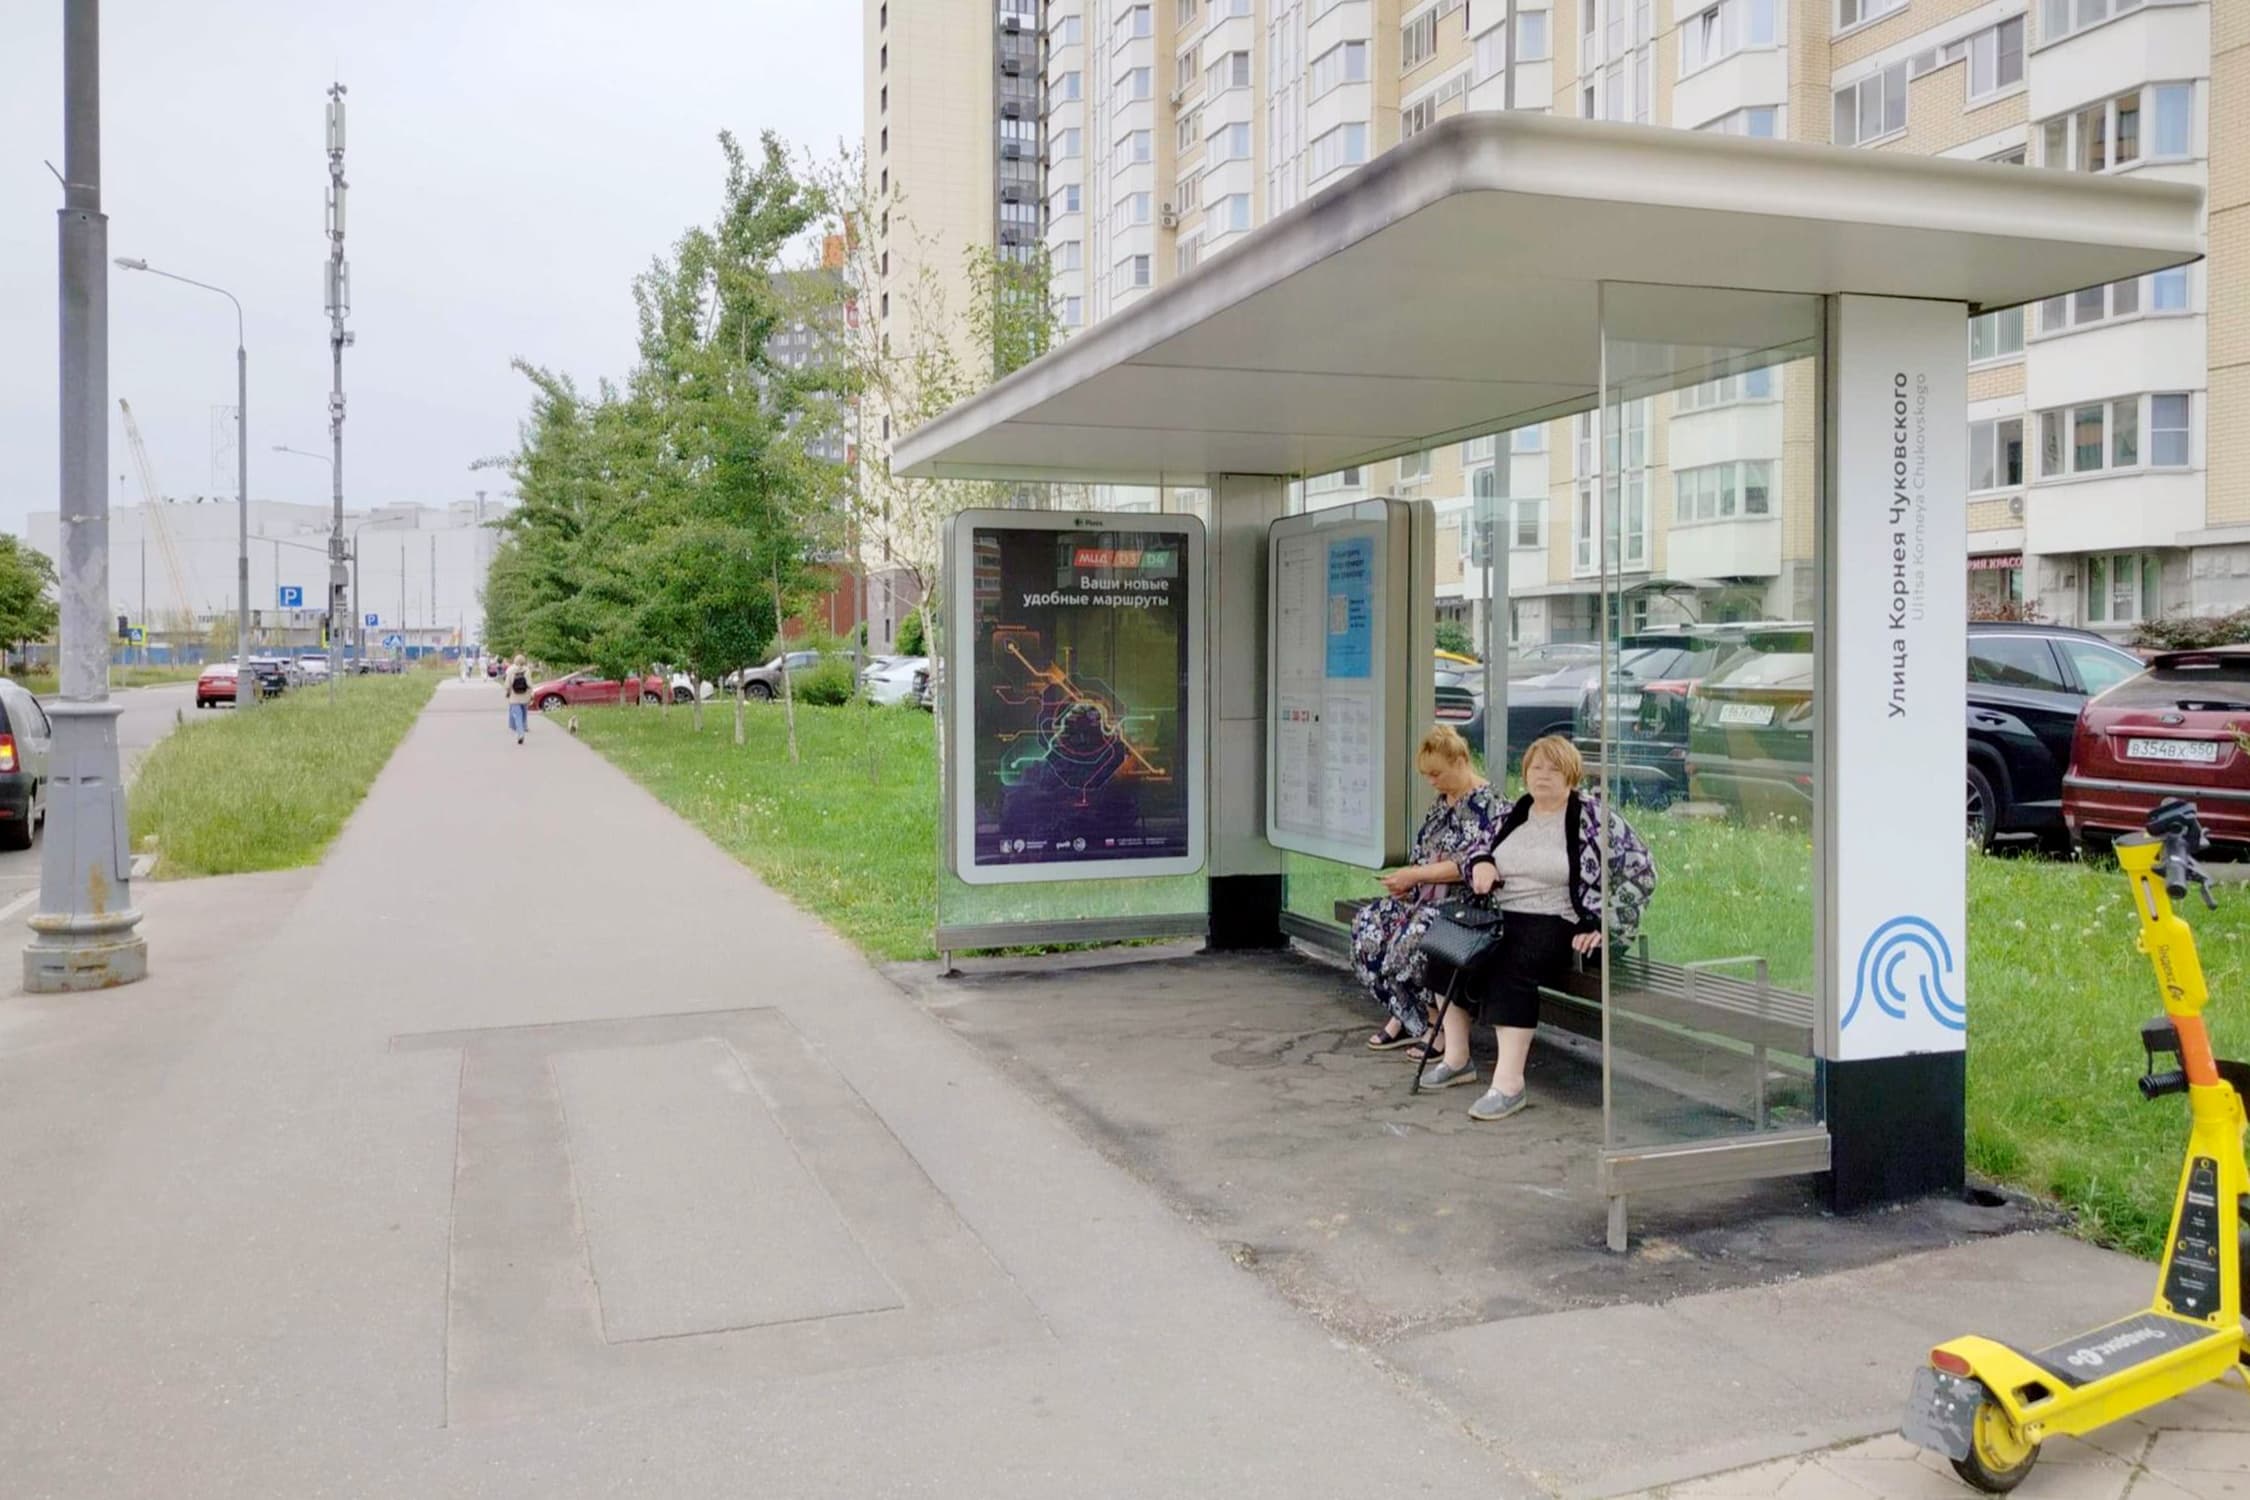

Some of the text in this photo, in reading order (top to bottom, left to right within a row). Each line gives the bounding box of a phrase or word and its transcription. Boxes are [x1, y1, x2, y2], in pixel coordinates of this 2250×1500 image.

[1911, 372, 1928, 621] Ulitsa Korneya Chukovskogo
[1888, 372, 1911, 719] Улица Корнея Чуковского
[1078, 553, 1109, 565] МЦД
[1080, 576, 1169, 590] Ваши новые
[284, 588, 297, 606] P
[1023, 591, 1169, 609] удобные маршруты
